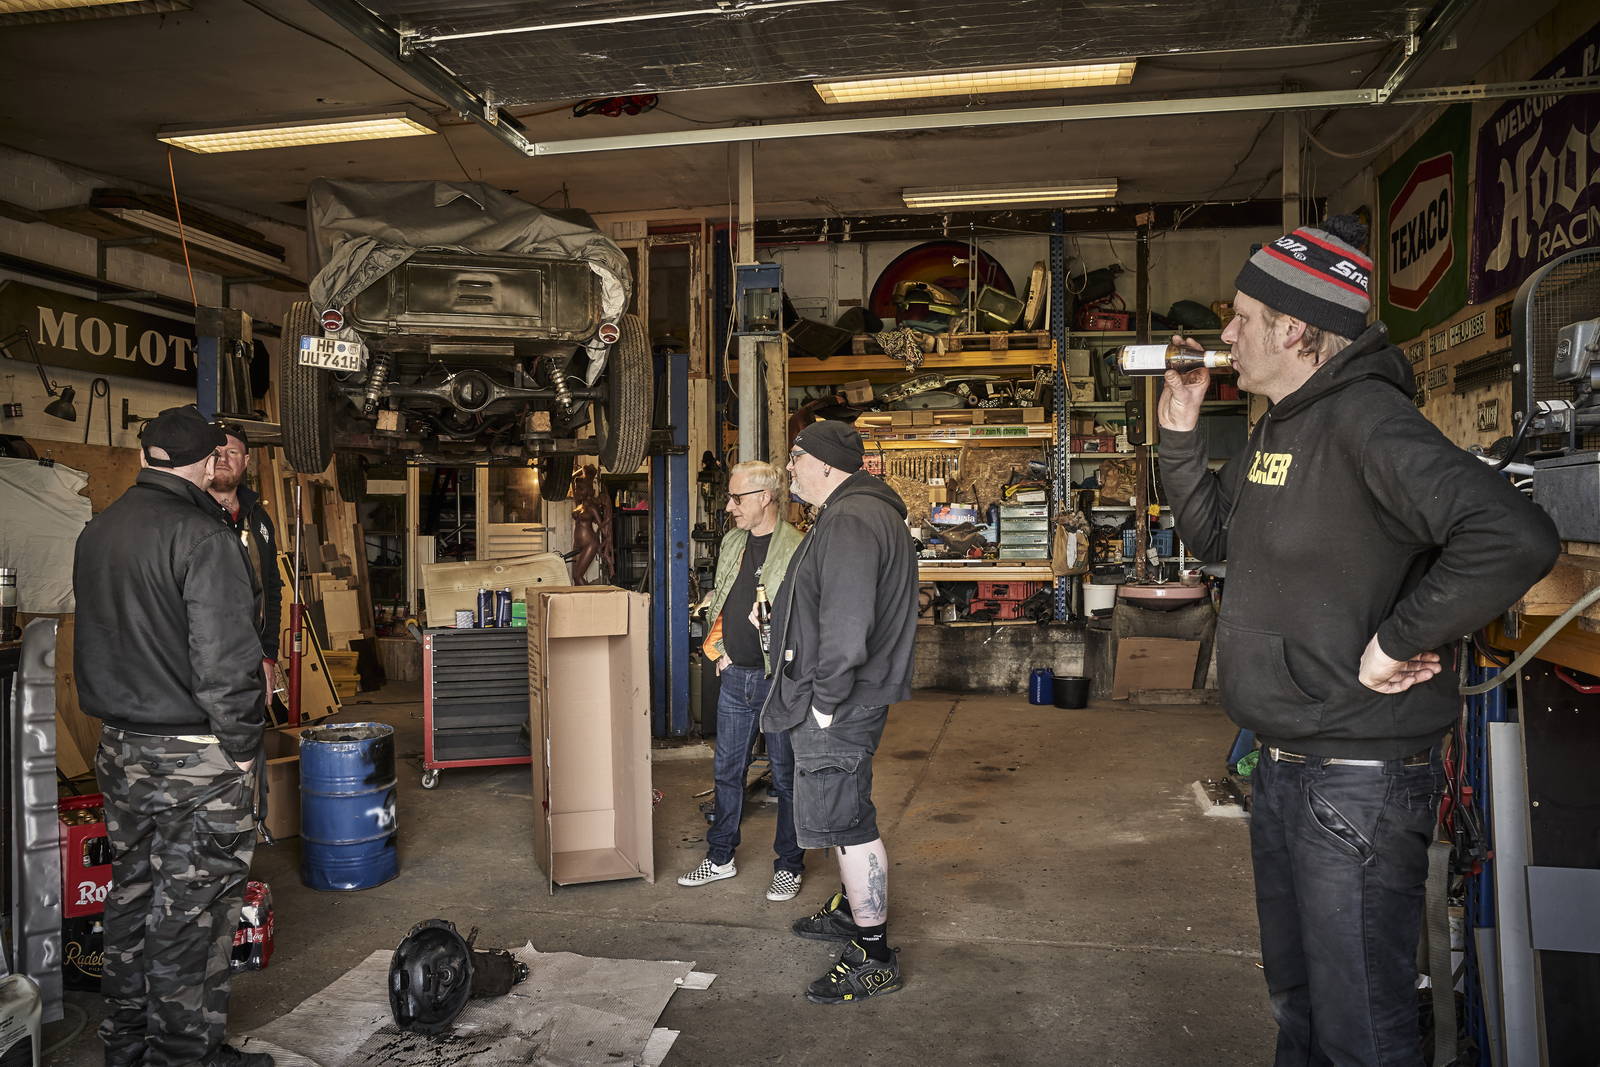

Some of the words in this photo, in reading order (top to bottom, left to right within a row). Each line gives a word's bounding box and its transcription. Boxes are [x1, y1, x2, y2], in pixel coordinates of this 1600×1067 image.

[1391, 187, 1449, 274] TEXACO
[37, 305, 198, 371] MOLOT
[316, 339, 336, 354] HH
[322, 353, 359, 370] 741H
